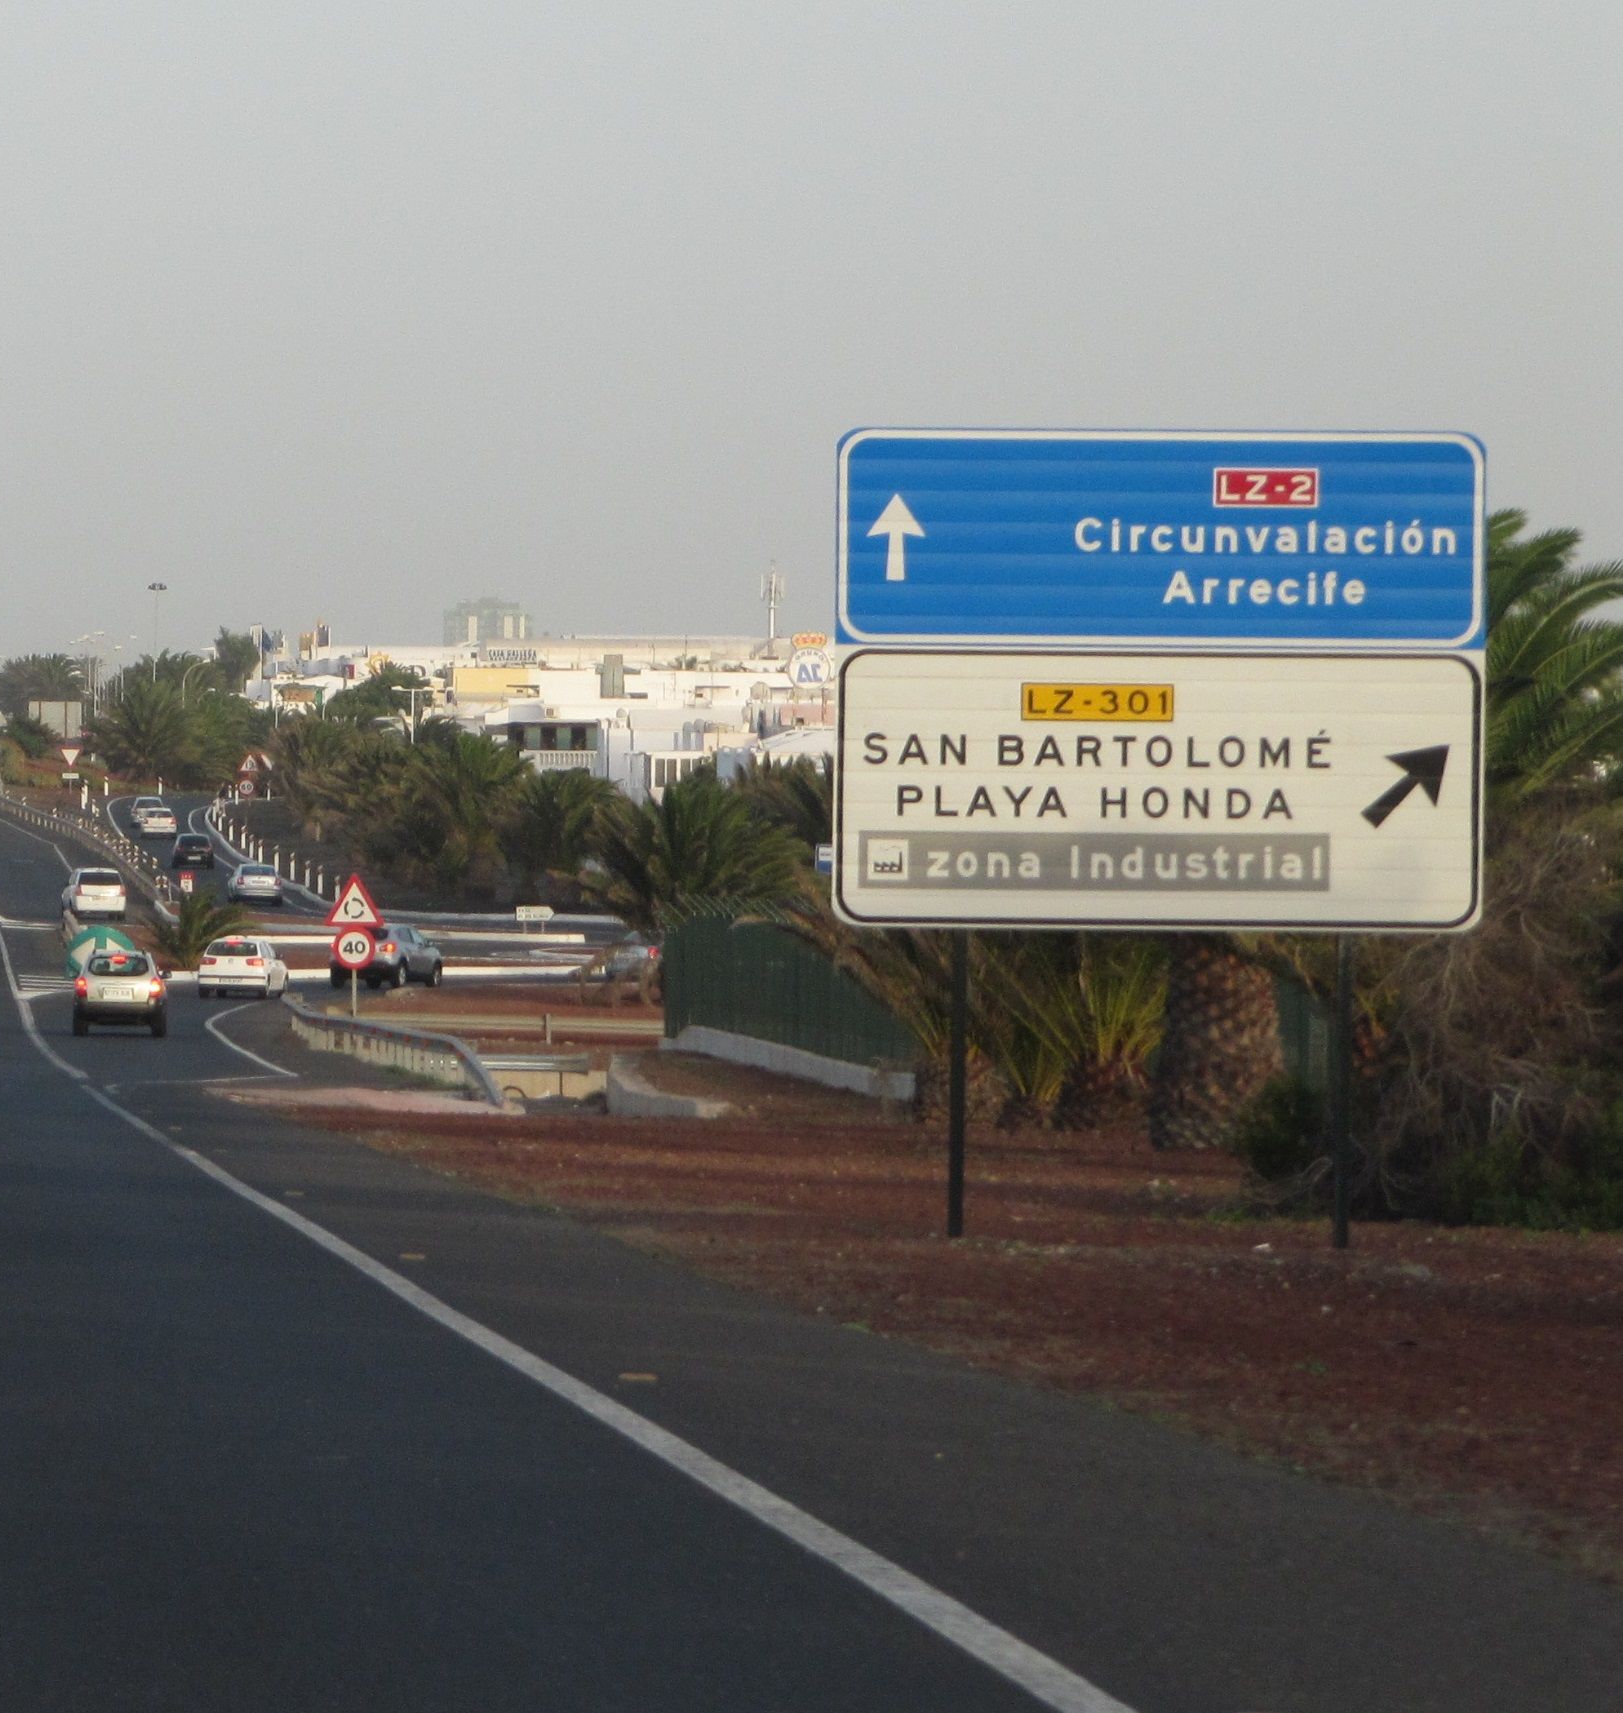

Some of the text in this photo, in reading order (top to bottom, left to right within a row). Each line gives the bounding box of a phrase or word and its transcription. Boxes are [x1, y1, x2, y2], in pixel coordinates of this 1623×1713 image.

[1219, 474, 1313, 501] LZ-2
[1075, 517, 1457, 555] Circunvalación
[1162, 570, 1366, 605] Arrecife
[1027, 690, 1169, 715] LZ-301
[863, 730, 1331, 769] SAN BARTOLOMÉ
[897, 785, 1293, 820] PLAYA HONDA
[926, 844, 1324, 881] zona Industrial
[343, 940, 366, 954] 40
